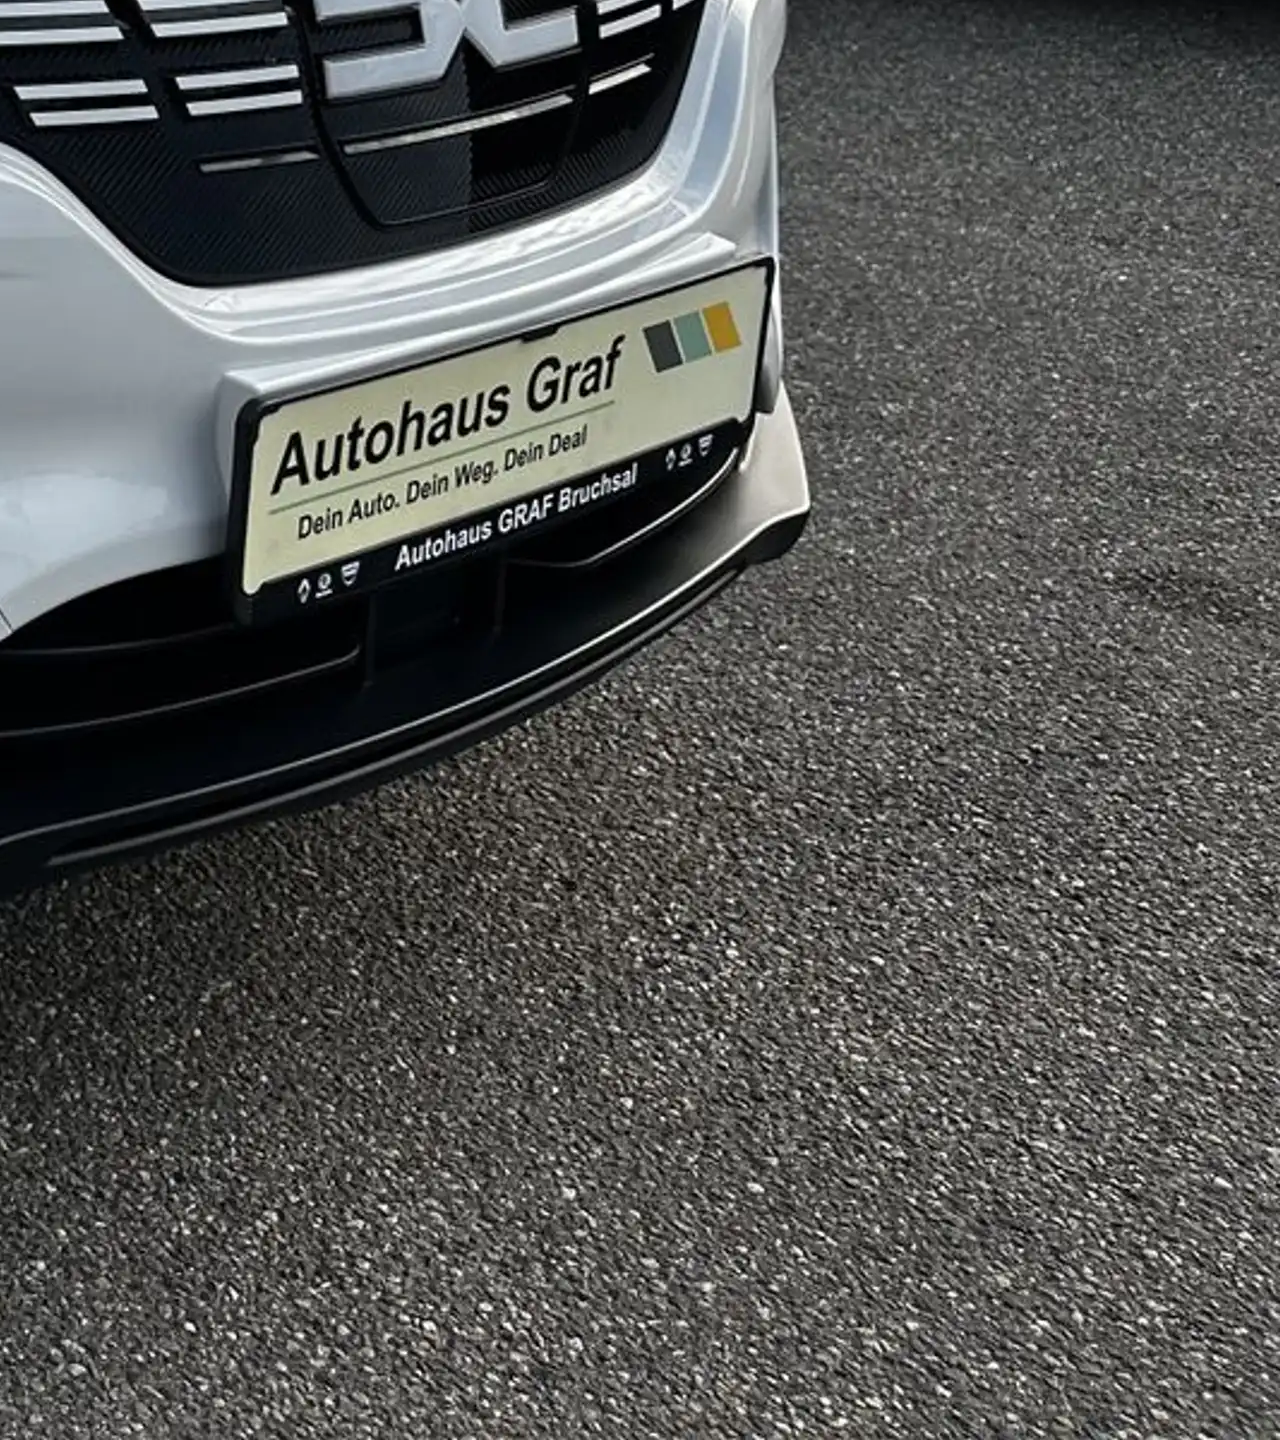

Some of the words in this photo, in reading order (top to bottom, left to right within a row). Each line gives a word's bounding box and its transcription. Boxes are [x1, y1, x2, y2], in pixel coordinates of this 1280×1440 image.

[270, 383, 512, 496] Autohaus
[526, 333, 627, 413] Graf
[297, 507, 344, 540] Dein
[348, 492, 401, 525] Auto.
[405, 472, 450, 505] Dein
[454, 458, 499, 487] Weg.
[504, 441, 545, 472] Dein
[548, 424, 588, 457] Deal
[394, 517, 493, 571] Autohaus
[497, 494, 555, 534] GRAF
[557, 462, 638, 513] Bruchsal
